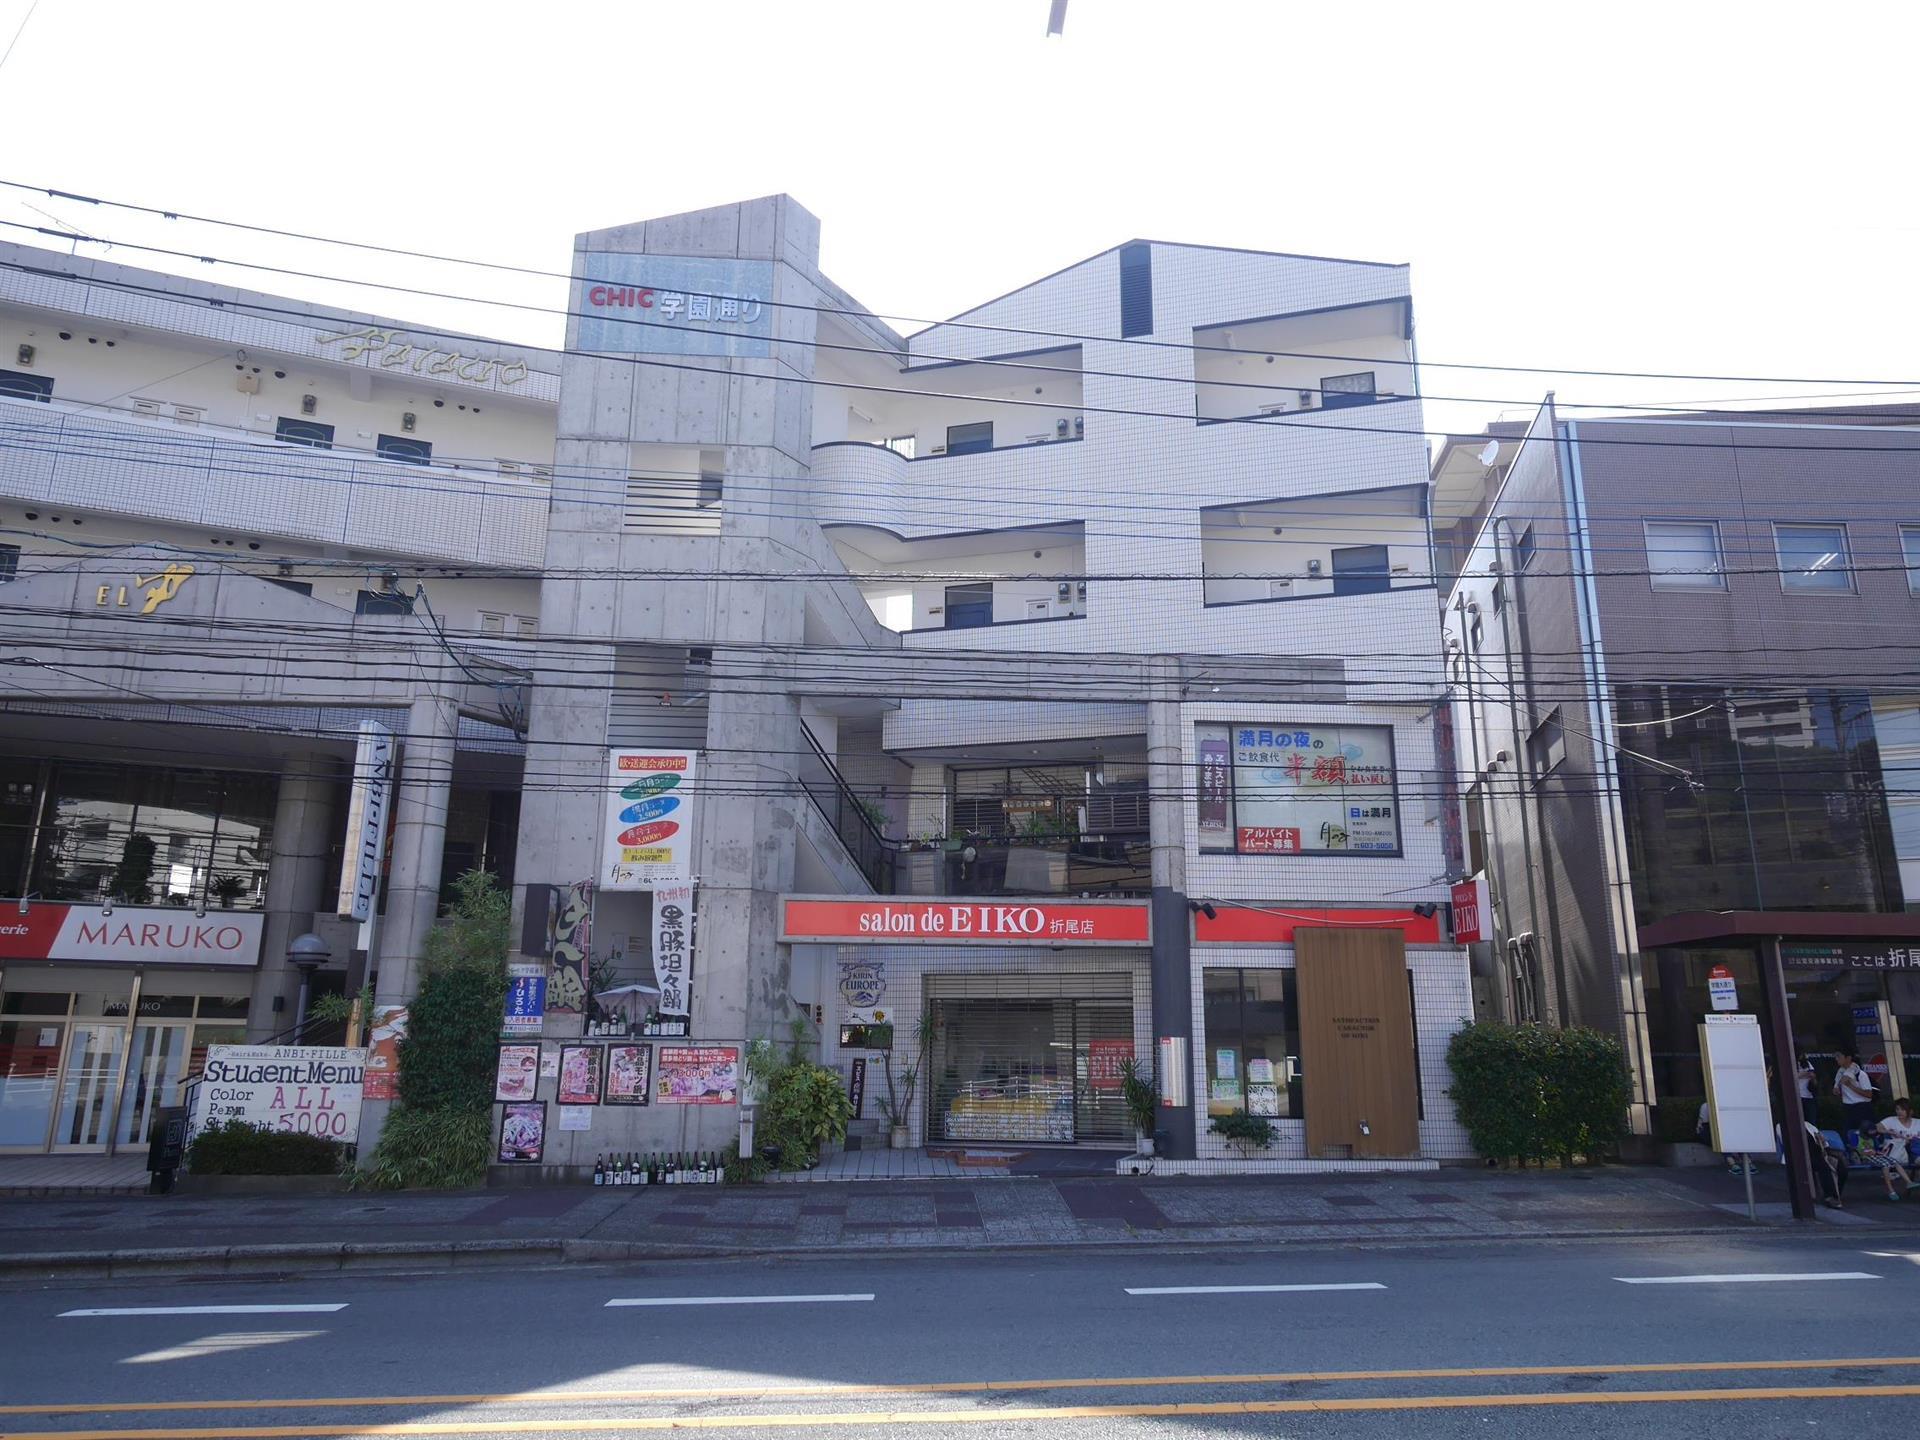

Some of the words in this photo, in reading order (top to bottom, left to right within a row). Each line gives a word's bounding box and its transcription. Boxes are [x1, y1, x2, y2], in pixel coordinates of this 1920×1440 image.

[590, 286, 654, 308] CHIC
[660, 290, 762, 323] 学園通り
[96, 585, 128, 606] EL
[1244, 828, 1293, 839] アルバイト
[1244, 839, 1294, 849] パート募集
[859, 909, 915, 932] salon
[921, 909, 944, 932] de
[949, 906, 1045, 934] EIKO
[1050, 919, 1094, 934] 折尾店
[1454, 904, 1478, 934] EIKO
[76, 920, 243, 950] MARUKO
[845, 980, 880, 990] EUROPE
[109, 1001, 161, 1011] MAUKO
[210, 1088, 254, 1101] Color
[269, 1086, 335, 1110] ALL
